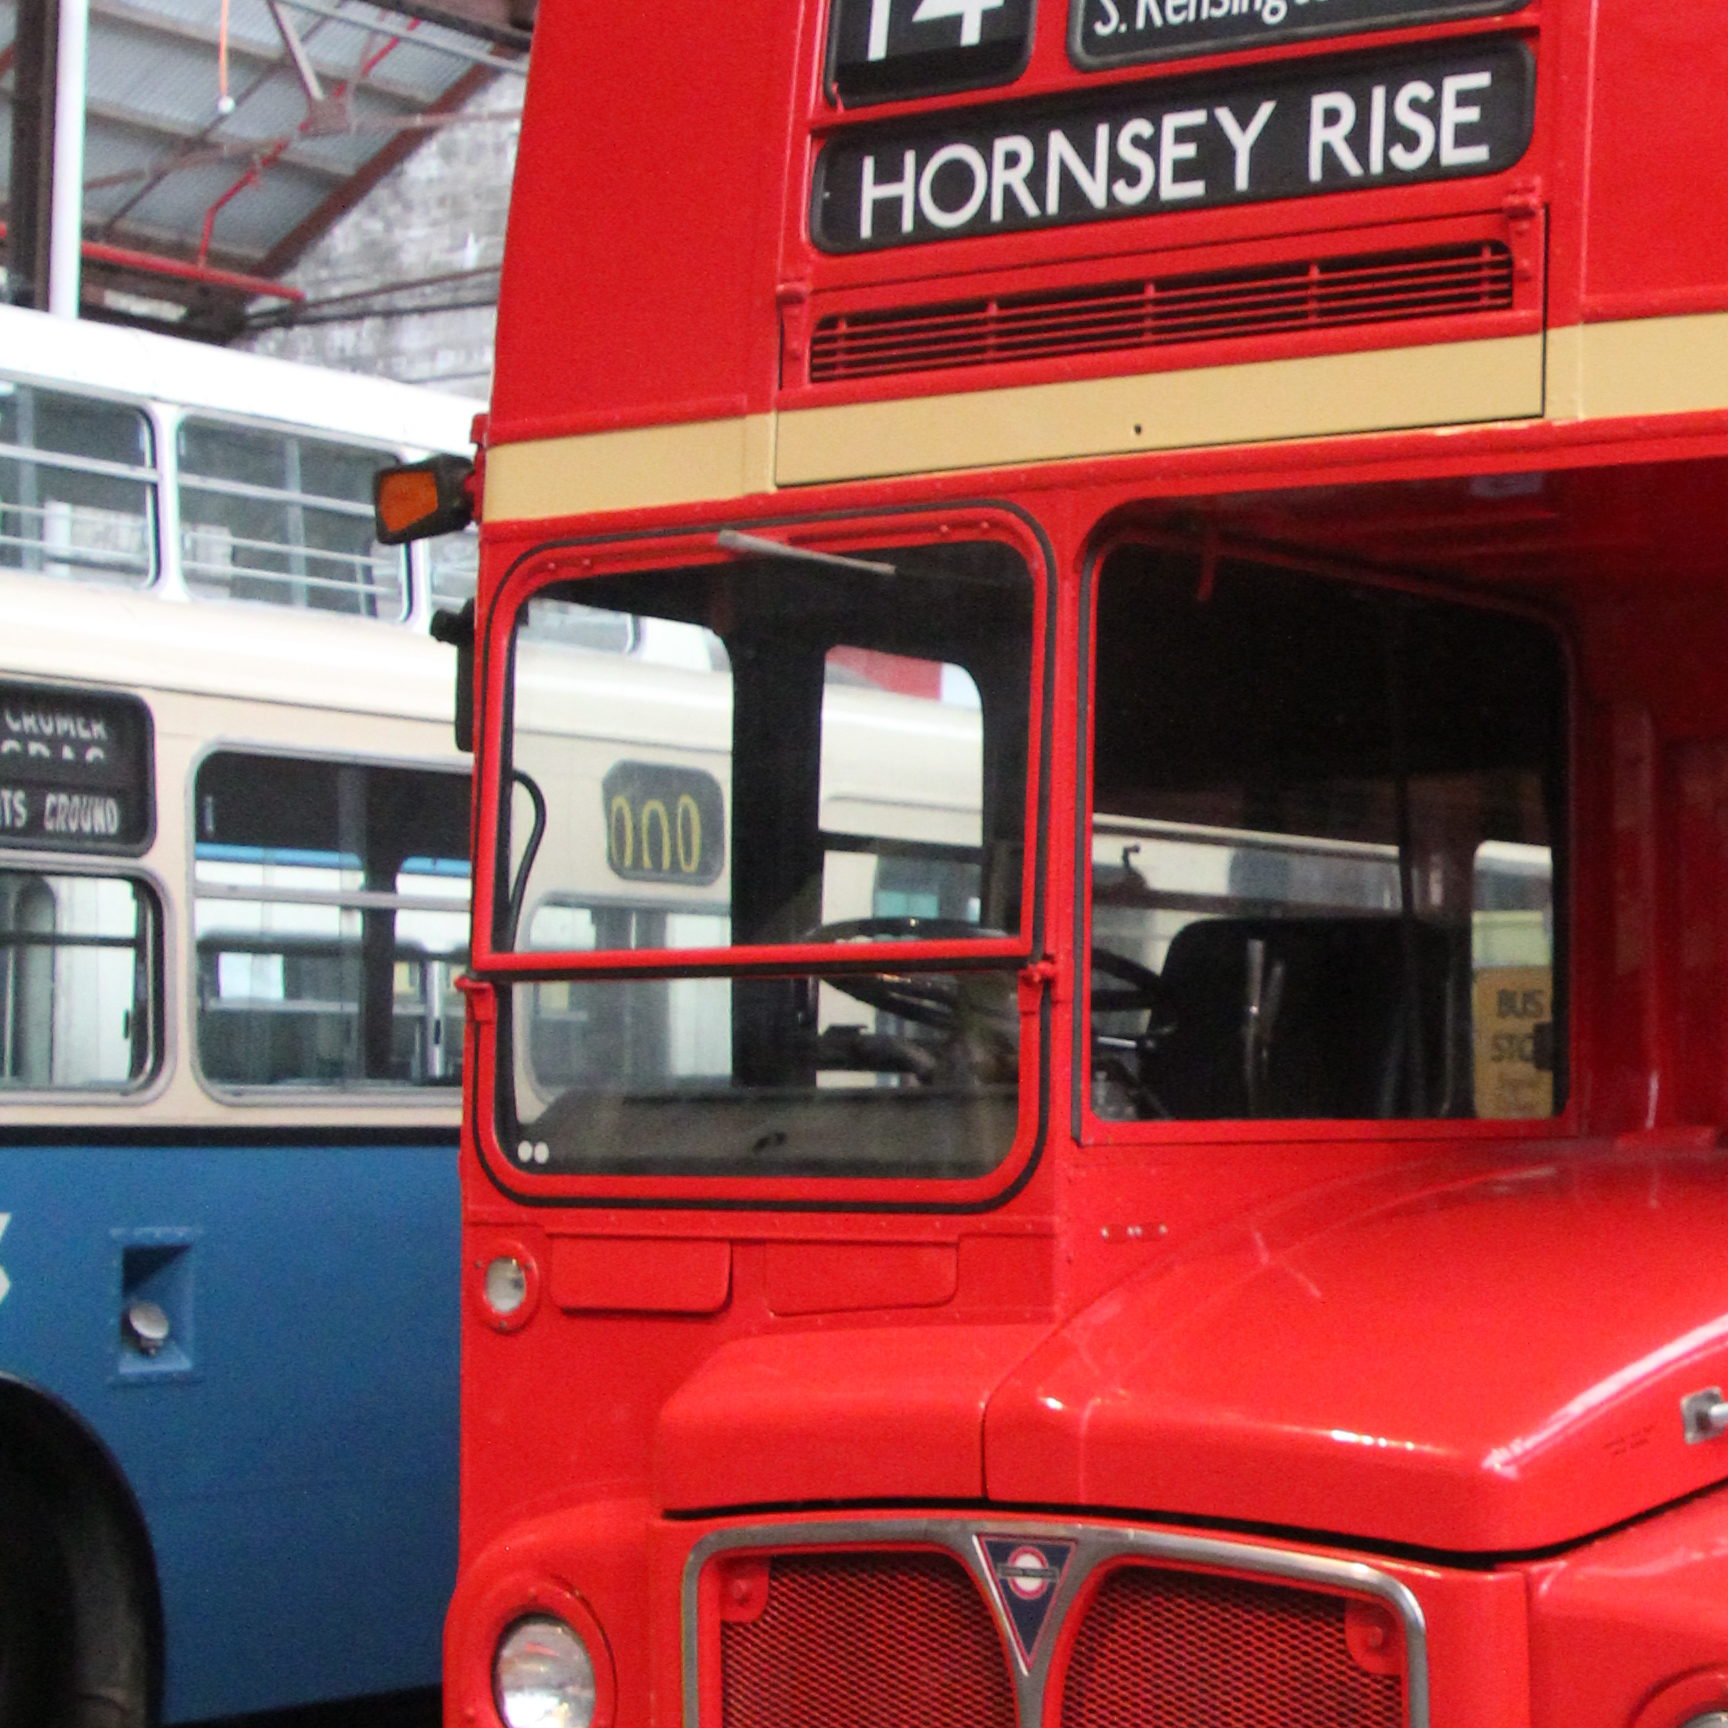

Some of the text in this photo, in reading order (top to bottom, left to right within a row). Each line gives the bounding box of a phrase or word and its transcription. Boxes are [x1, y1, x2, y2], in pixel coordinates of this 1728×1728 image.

[860, 71, 1493, 240] HORNSEY RISE
[1497, 988, 1543, 1018] BUS
